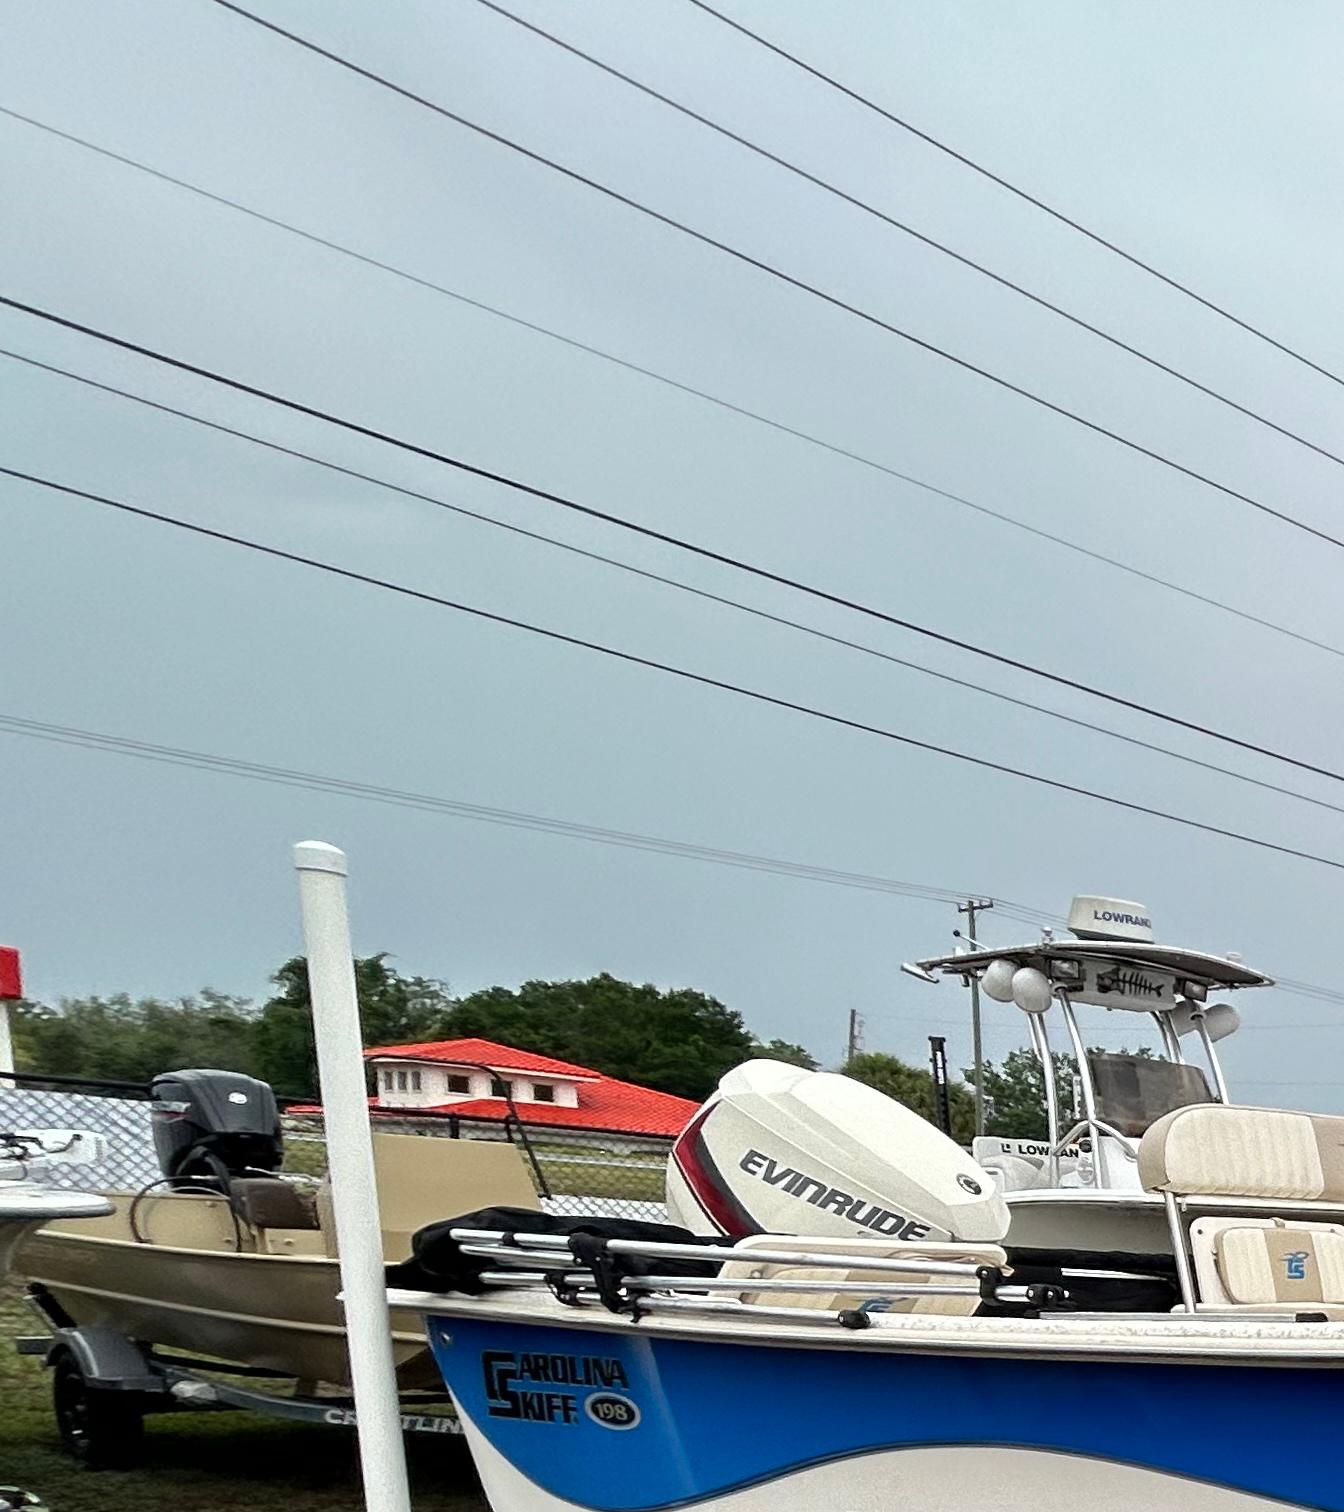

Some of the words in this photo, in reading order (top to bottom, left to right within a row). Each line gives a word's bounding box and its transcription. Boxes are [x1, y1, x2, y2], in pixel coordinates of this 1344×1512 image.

[739, 1149, 931, 1241] EVINRUDE
[481, 1350, 631, 1400] CAROLINA
[488, 1368, 574, 1424] SKIFF
[594, 1402, 628, 1421] 198
